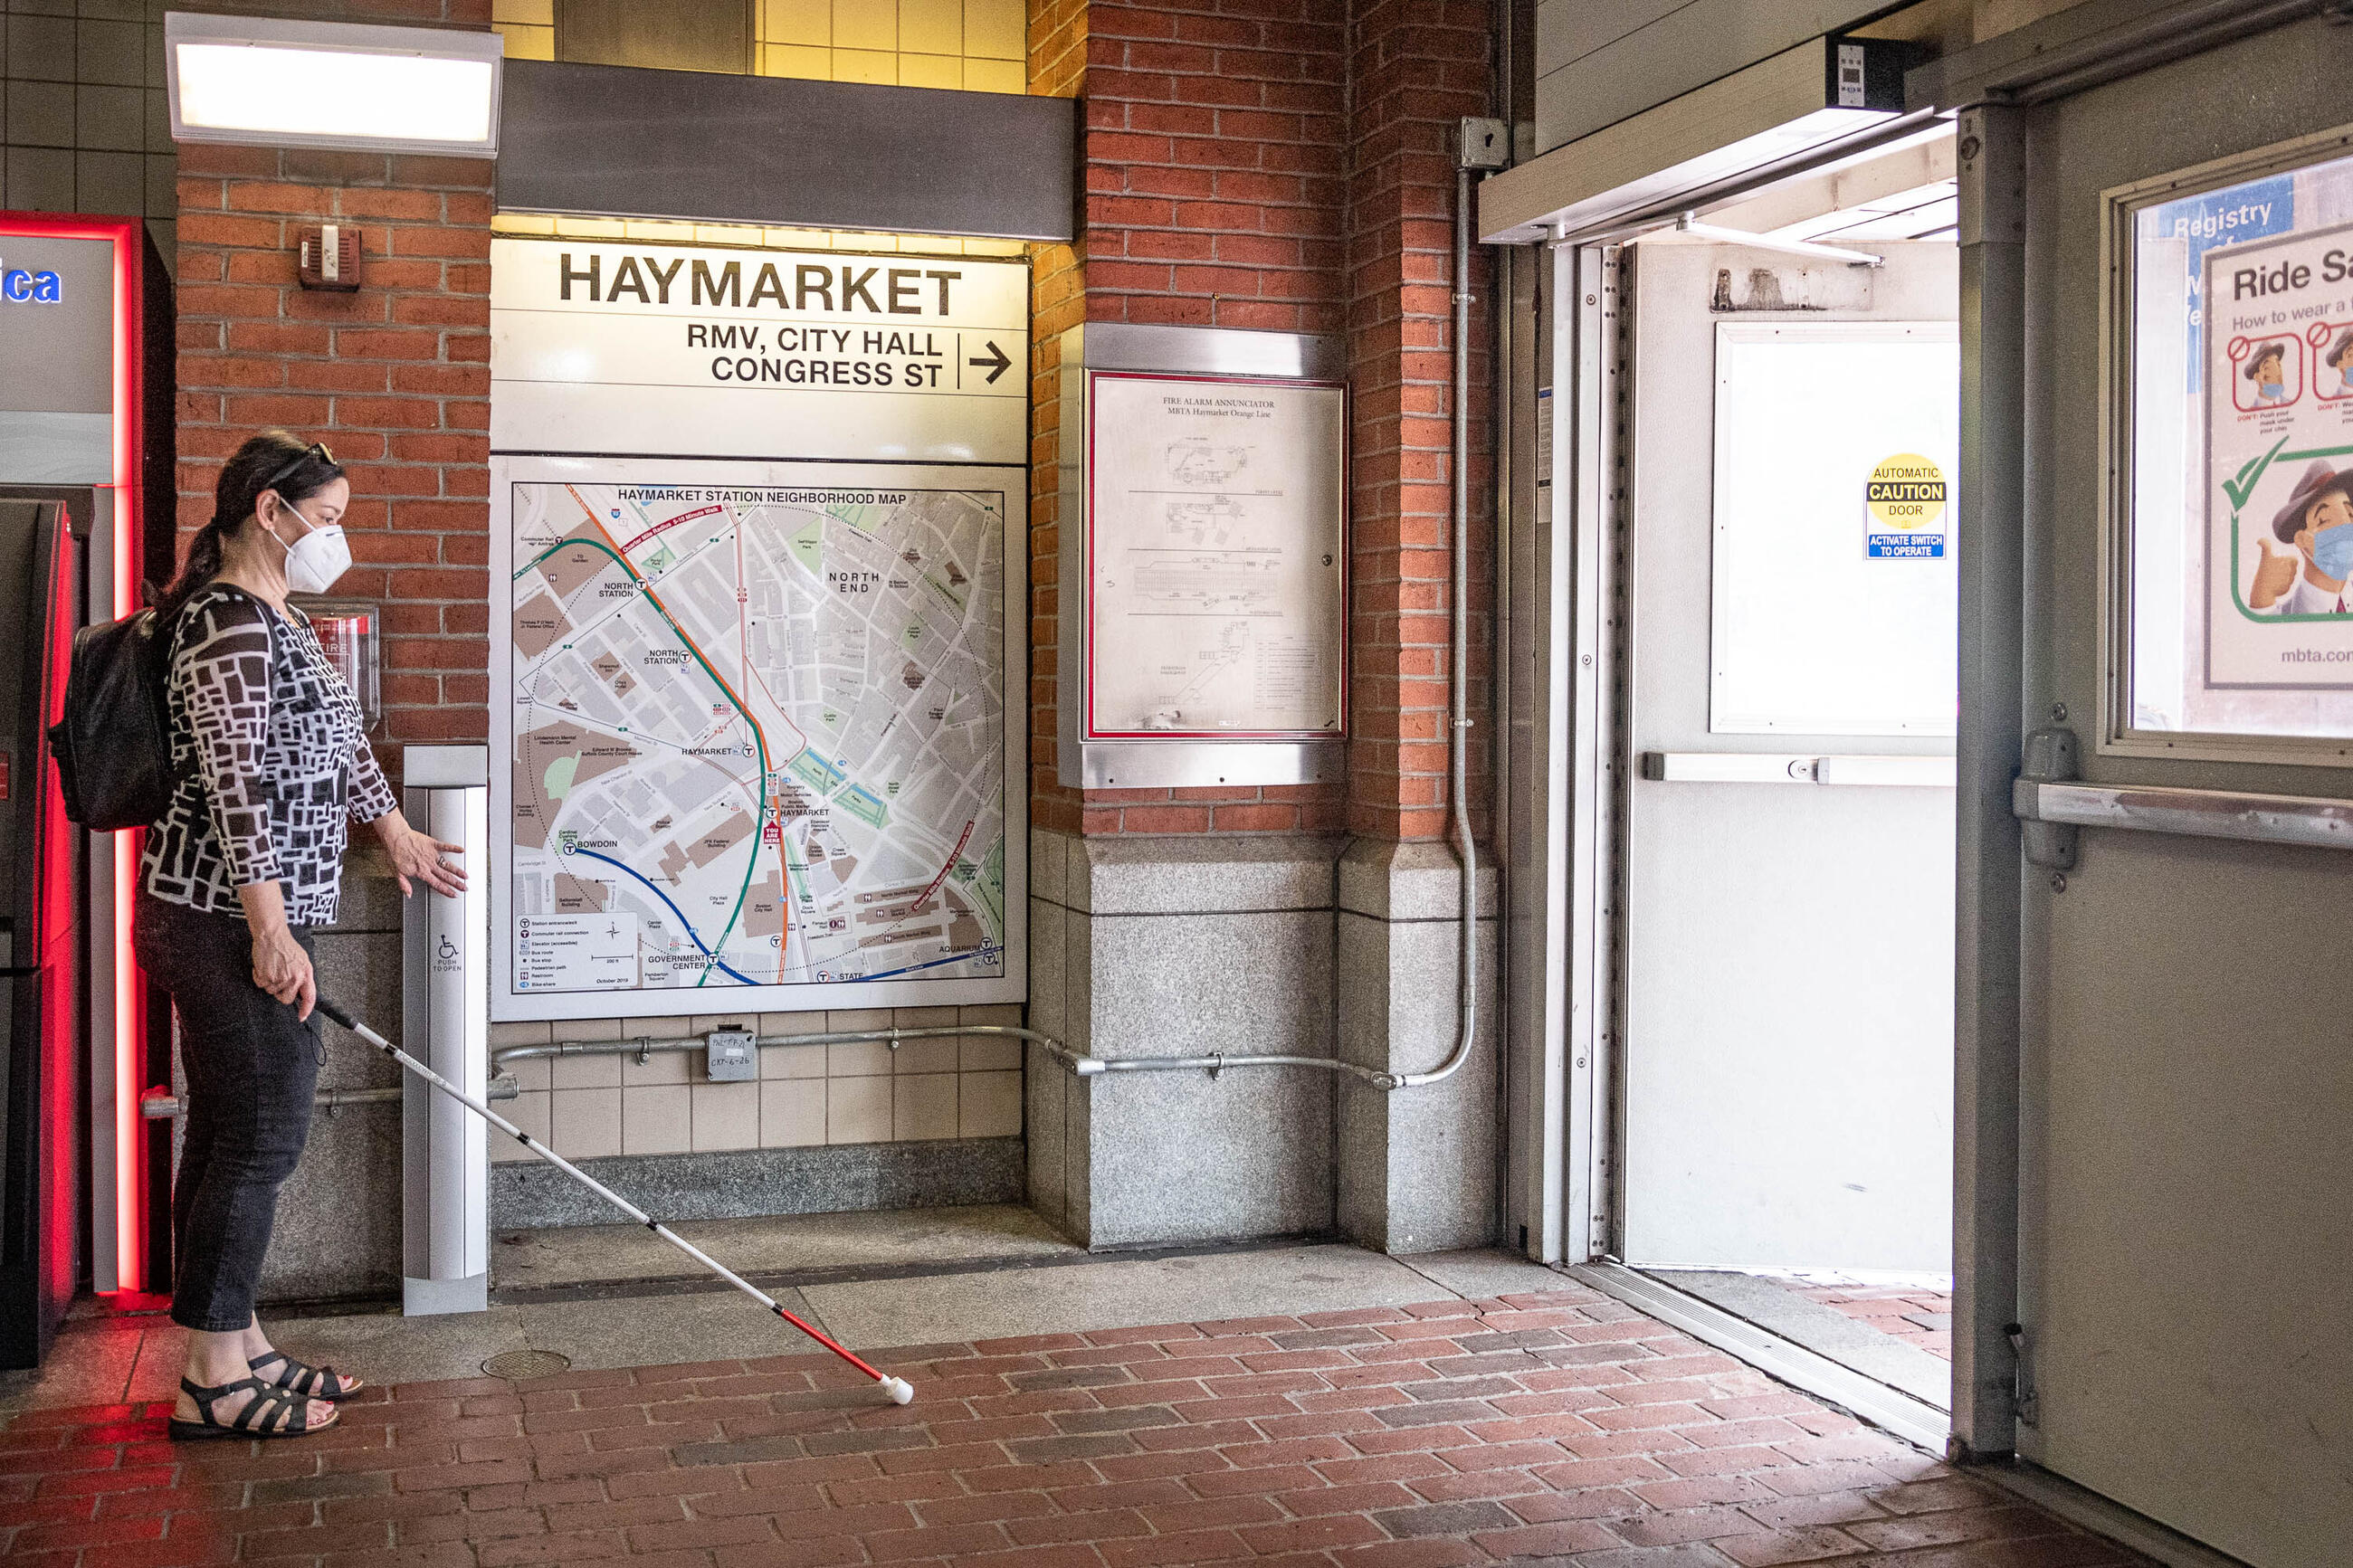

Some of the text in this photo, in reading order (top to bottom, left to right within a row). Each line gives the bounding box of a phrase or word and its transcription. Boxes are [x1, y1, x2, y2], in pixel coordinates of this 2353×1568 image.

[2174, 203, 2272, 238] Registry
[0, 258, 62, 303] ca
[2234, 260, 2310, 300] Ride
[2322, 249, 2353, 282] S
[560, 253, 962, 316] HAYMARKET
[2233, 300, 2345, 331] How to wear a
[687, 324, 943, 357] RMV, CITY HALL
[711, 356, 943, 388] CONGRESS ST
[1163, 396, 1274, 408] FIRE ALARM ANNUNCIATOR
[1167, 407, 1271, 419] MBTA Haymarket Orange Line
[1873, 467, 1939, 479] AUTOMATIC
[618, 489, 906, 505] HAYMARKET STATION NEIGHBORHOOD MAP
[1869, 484, 1943, 500] CAUTION
[1889, 505, 1923, 516] DOOR
[1870, 535, 1943, 546] ACTIVATE SWITCH
[1880, 546, 1932, 556] TO OPERATE
[829, 573, 880, 582] NORTH
[840, 584, 869, 593] END
[681, 747, 732, 755] HAYMARKET
[577, 841, 618, 849] BOWDOIN
[939, 945, 980, 953] AQUARIUM
[648, 955, 706, 963] GOVERNMENT
[672, 962, 706, 970] CENTER
